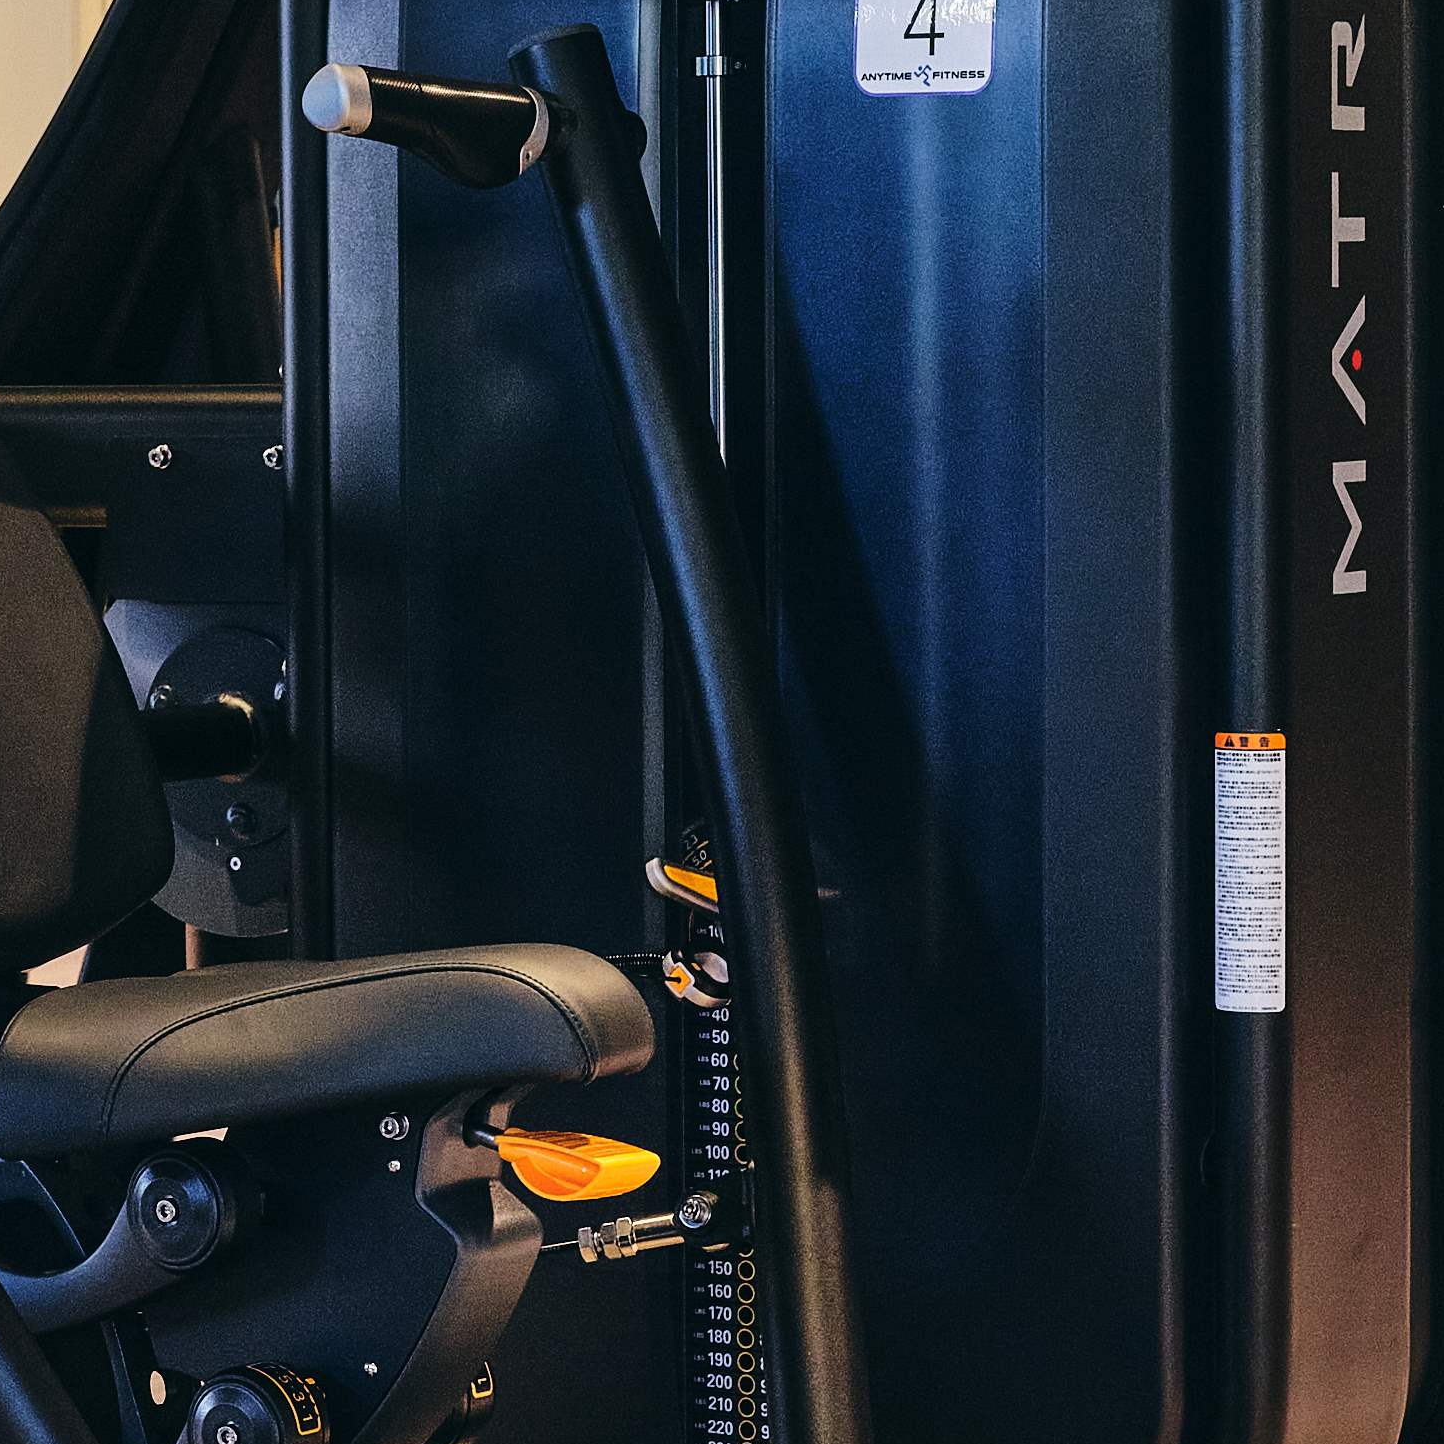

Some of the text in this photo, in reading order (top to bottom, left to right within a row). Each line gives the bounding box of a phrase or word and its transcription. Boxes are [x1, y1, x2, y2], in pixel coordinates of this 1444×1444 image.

[861, 70, 985, 81] ANYTIME FITNESS
[712, 1008, 729, 1022] 40
[712, 1030, 729, 1044] 50
[711, 1053, 728, 1067] 60
[712, 1076, 729, 1091] 70
[712, 1099, 729, 1113] 80
[712, 1122, 729, 1136] 90
[705, 1145, 729, 1160] 100
[708, 1260, 732, 1275] 150
[707, 1284, 732, 1299] 160
[709, 1306, 732, 1321] 170
[707, 1329, 731, 1344] 180
[708, 1352, 732, 1367] 190
[706, 1374, 733, 1390] 200
[293, 1392, 305, 1402] 3
[708, 1396, 733, 1412] 210
[708, 1420, 734, 1436] 220
